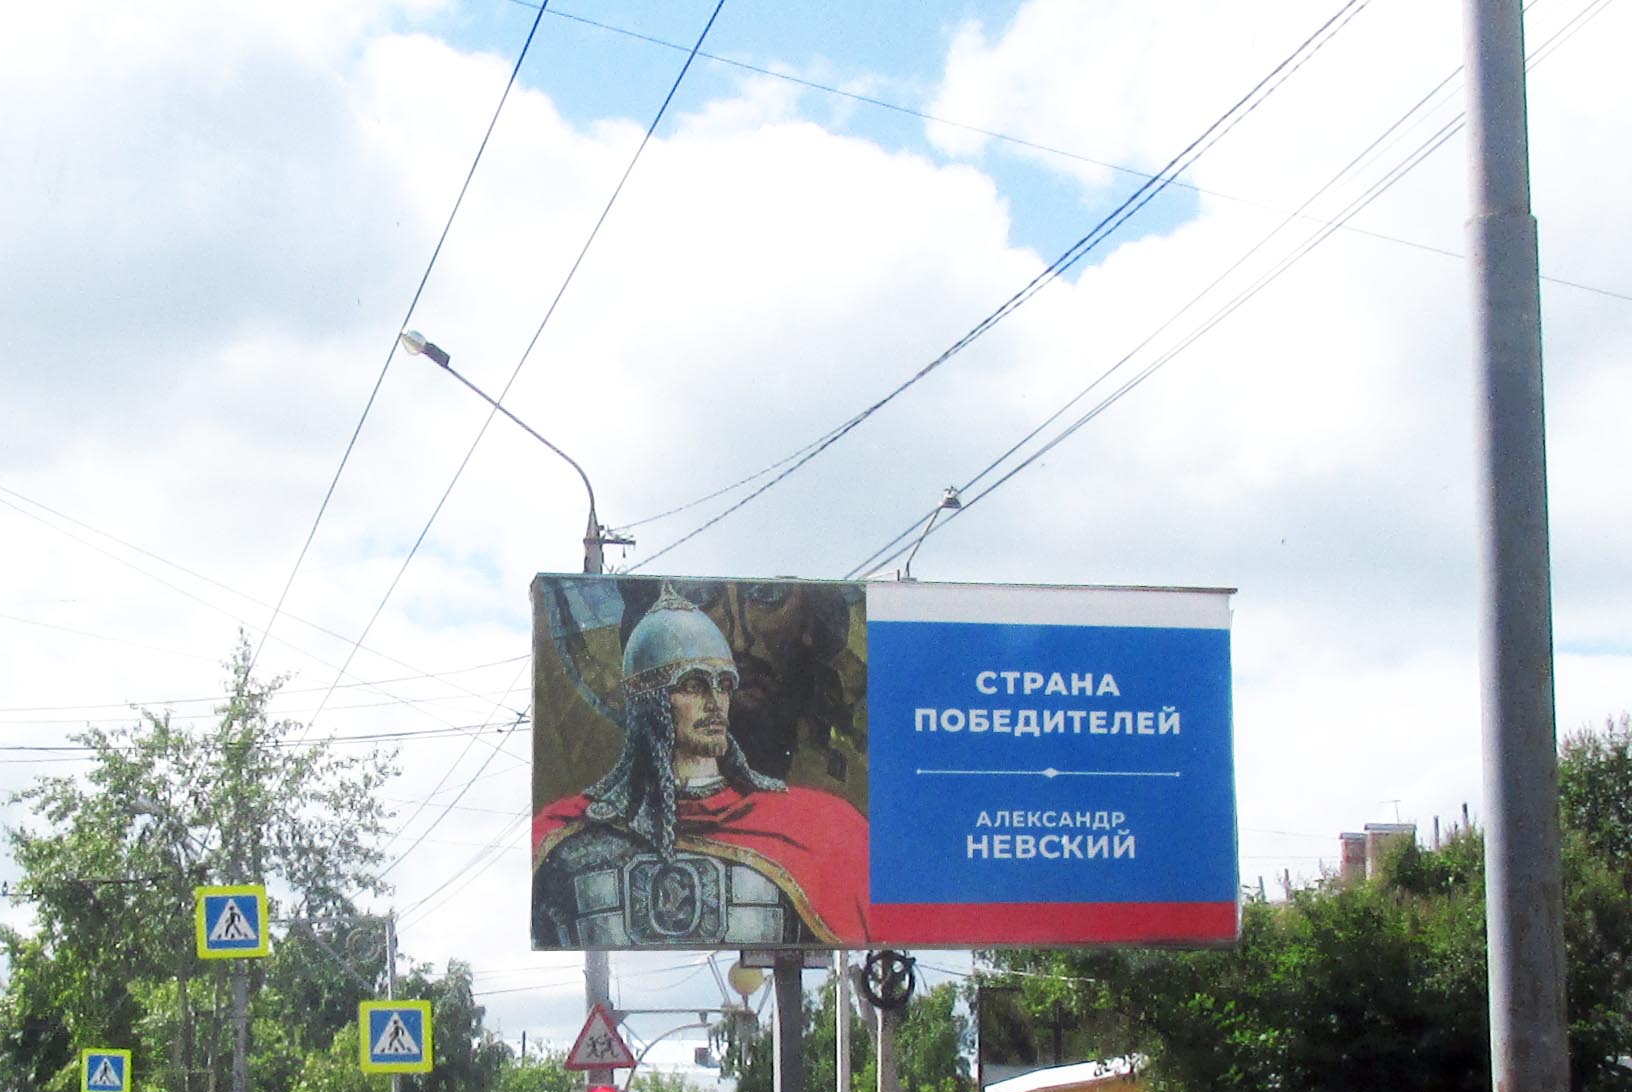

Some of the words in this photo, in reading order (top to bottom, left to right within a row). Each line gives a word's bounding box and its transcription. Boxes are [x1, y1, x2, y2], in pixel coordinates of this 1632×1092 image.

[975, 670, 1121, 697] СТРАНА
[914, 705, 1181, 737] ПОБЕДИТЕЛЕЙ
[975, 810, 1126, 831] АЛЕКСАНДР
[966, 828, 1136, 859] НЕВСКИЙ
